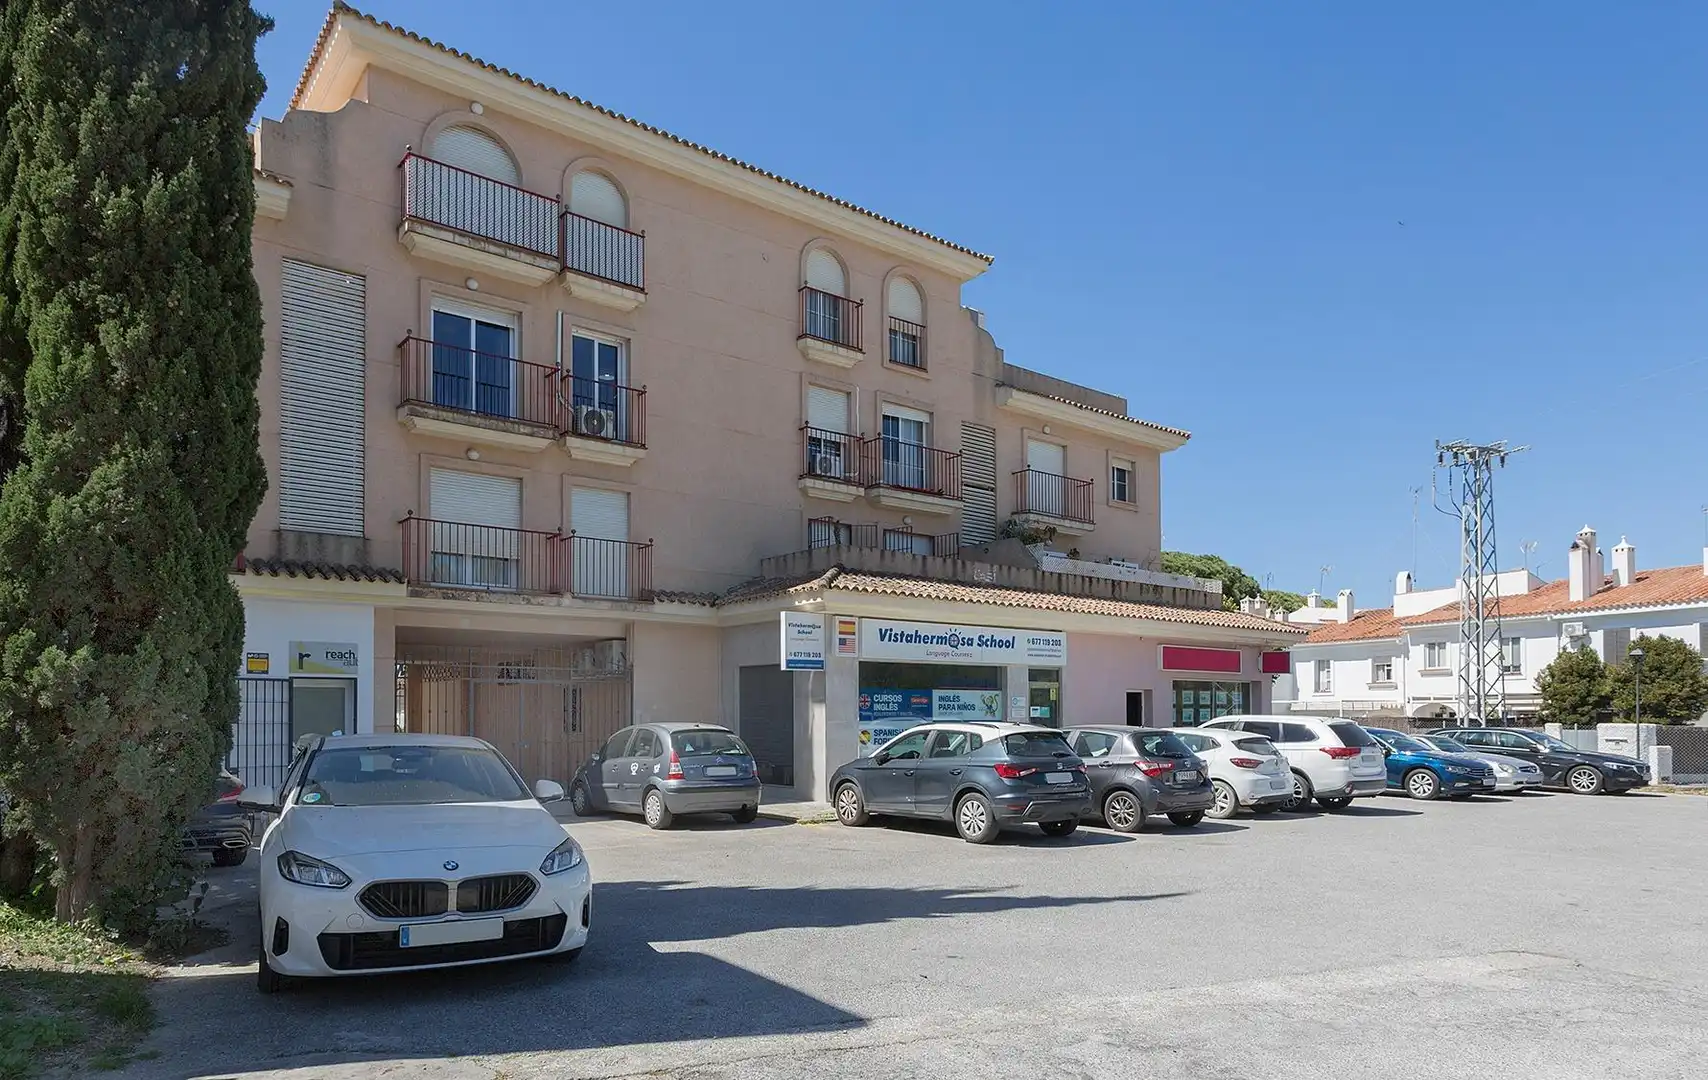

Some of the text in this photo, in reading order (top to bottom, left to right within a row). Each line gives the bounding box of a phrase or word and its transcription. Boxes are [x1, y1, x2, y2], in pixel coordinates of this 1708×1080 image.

[977, 634, 1016, 650] School
[1031, 637, 1041, 646] 677
[325, 649, 356, 660] reach
[926, 649, 950, 658] Language
[873, 694, 903, 702] CURSOS
[938, 694, 961, 703] INGLÉS
[873, 701, 899, 711] INGLÉS
[938, 703, 957, 711] PARA
[957, 702, 976, 711] NIÑOS
